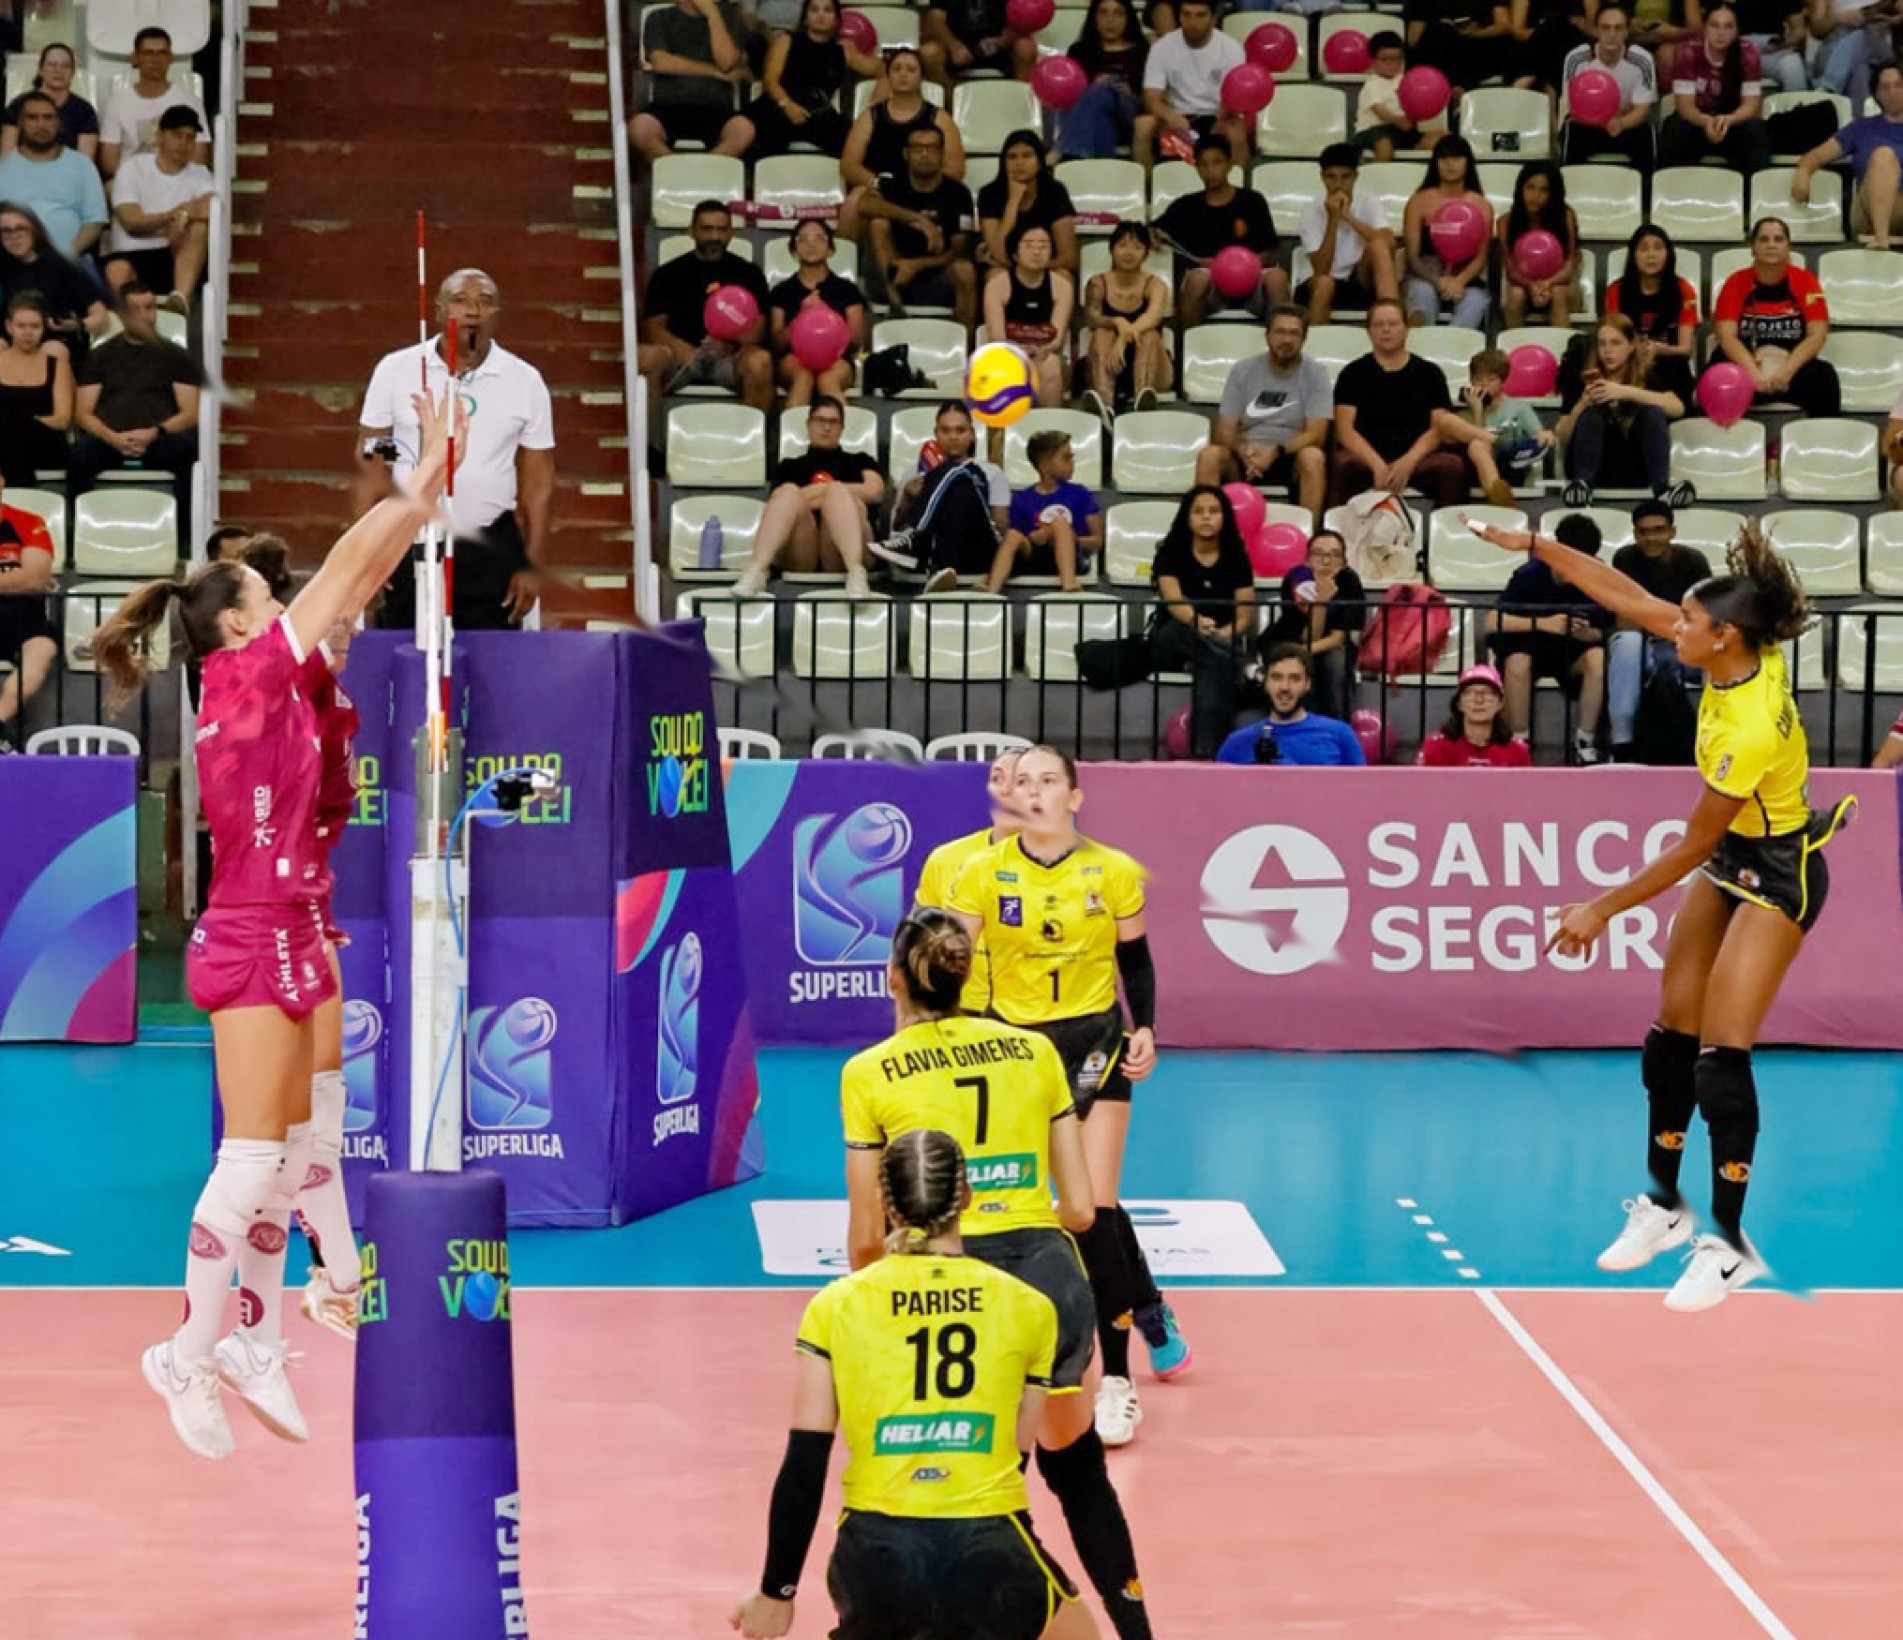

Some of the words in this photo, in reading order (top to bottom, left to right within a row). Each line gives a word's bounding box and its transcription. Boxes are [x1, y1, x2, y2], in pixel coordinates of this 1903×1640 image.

[1367, 820, 1692, 888] SANCO
[1370, 904, 1679, 972] SEGUR
[789, 971, 887, 1004] SUPERLI
[1048, 969, 1060, 1003] 1
[881, 1047, 953, 1082] FLAVIA
[951, 1037, 1034, 1069] GIMENES
[653, 1103, 700, 1147] SUPERLIGA
[954, 1075, 989, 1146] 7
[463, 1133, 565, 1161] SUPERLIGA
[447, 1240, 498, 1272] SOU
[891, 1287, 984, 1316] PARISE
[906, 1322, 977, 1402] 18
[880, 1420, 972, 1445] HELIAR
